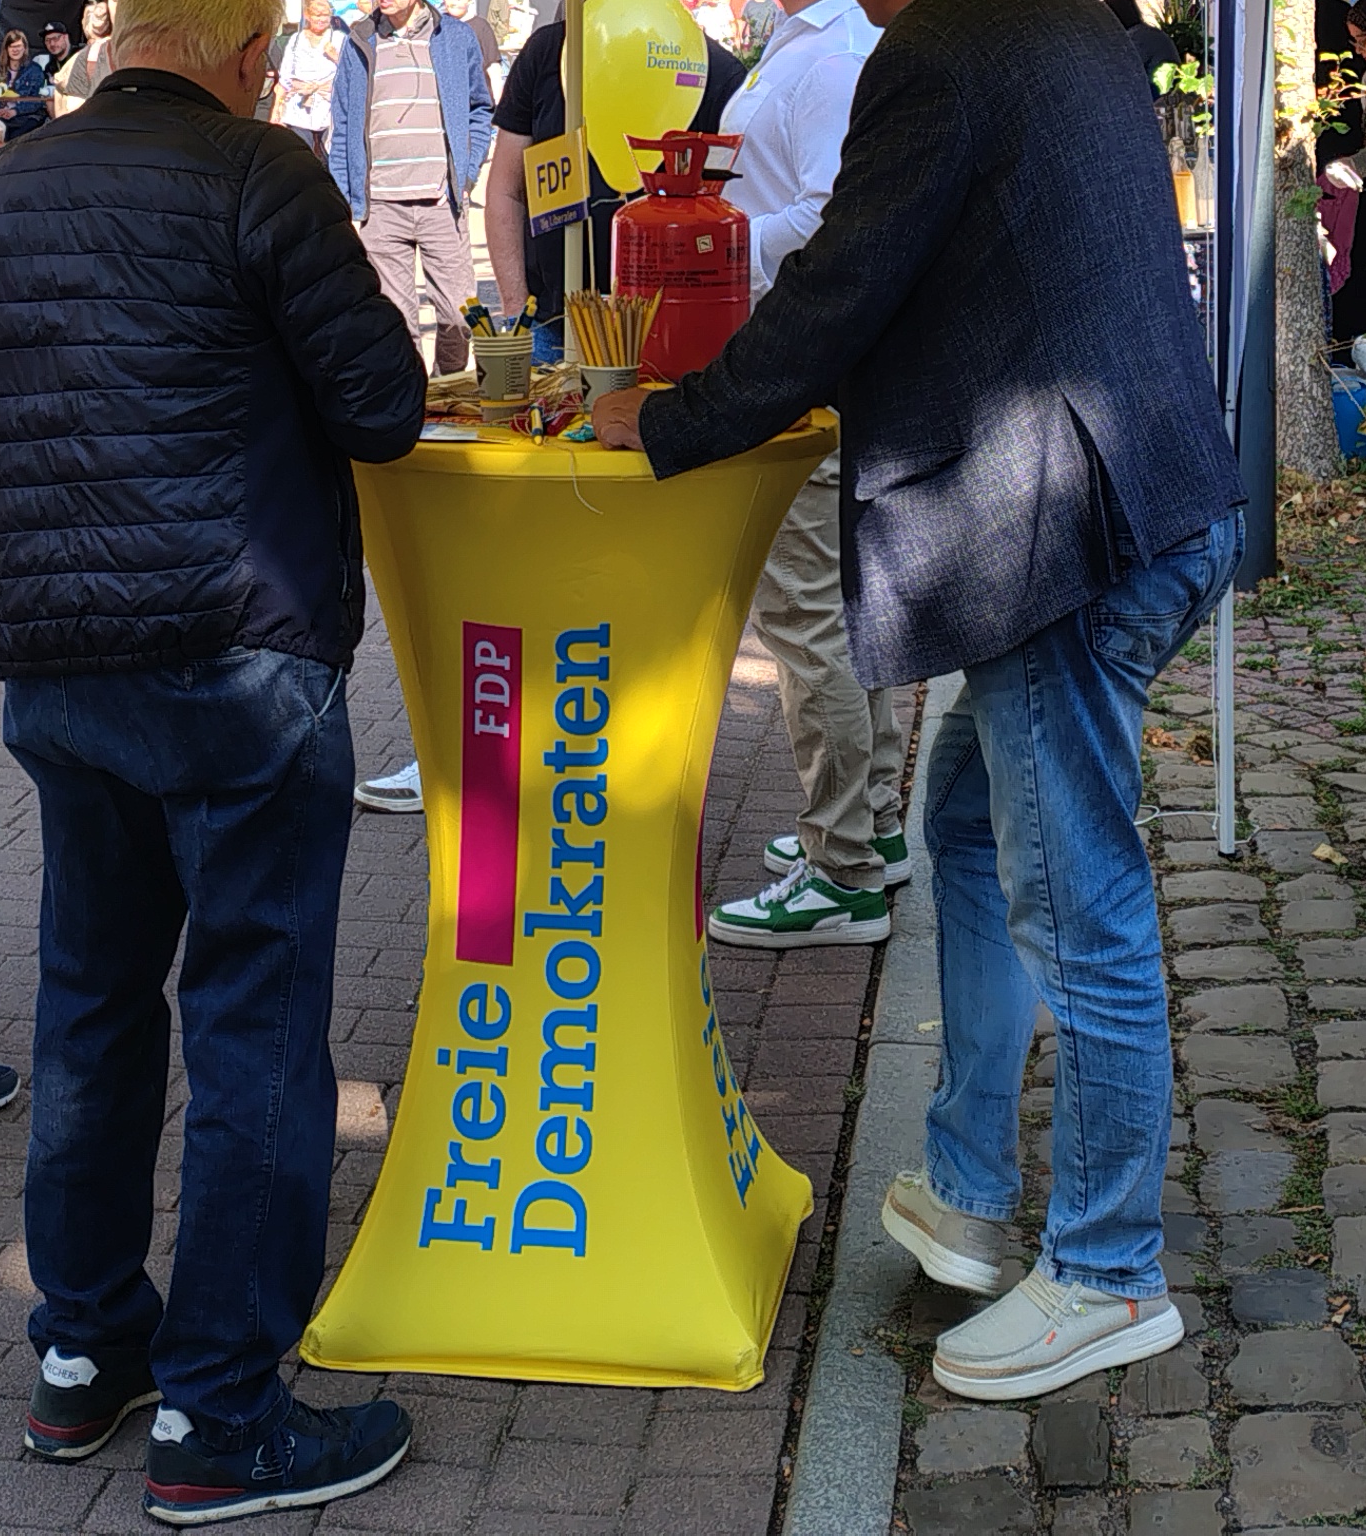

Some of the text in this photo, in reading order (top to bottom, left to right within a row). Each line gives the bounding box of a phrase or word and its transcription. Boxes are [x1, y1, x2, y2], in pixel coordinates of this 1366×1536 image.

[647, 41, 681, 55] Freie
[536, 156, 572, 199] FDP
[474, 639, 511, 739] FDP
[509, 622, 611, 1258] Demokraten
[419, 982, 512, 1251] Freie
